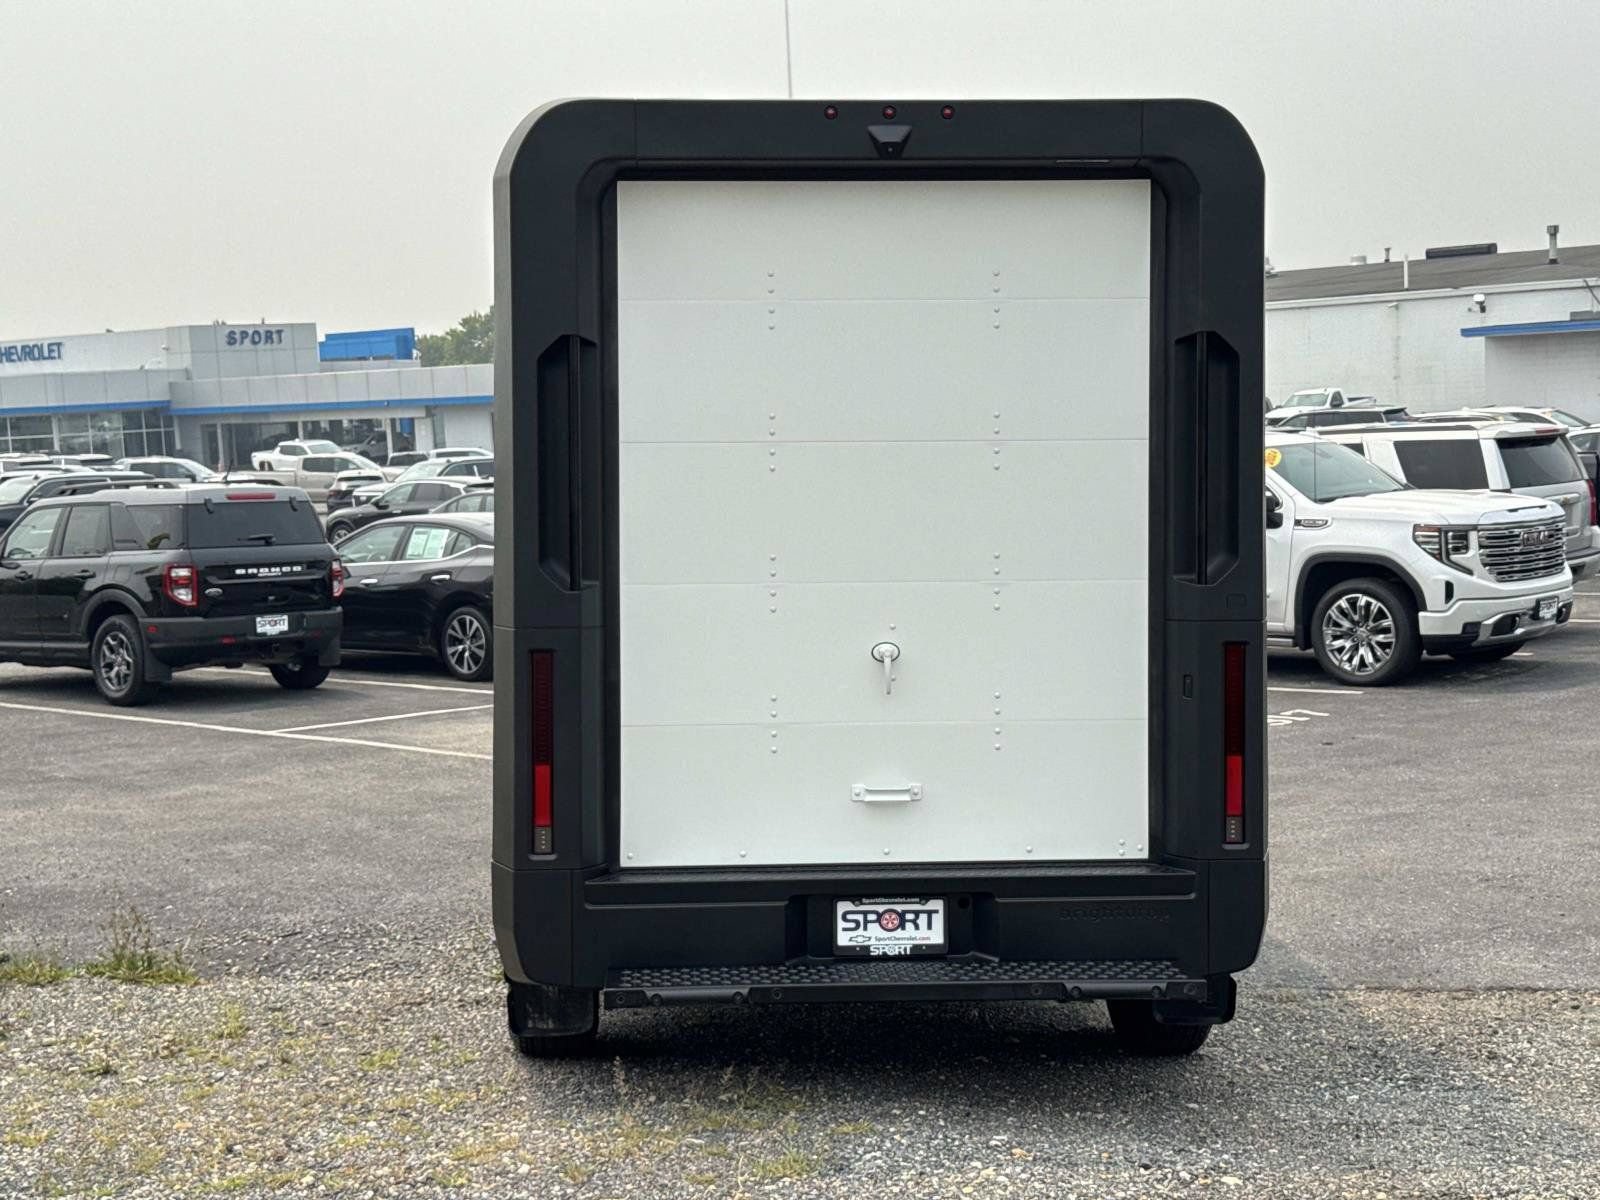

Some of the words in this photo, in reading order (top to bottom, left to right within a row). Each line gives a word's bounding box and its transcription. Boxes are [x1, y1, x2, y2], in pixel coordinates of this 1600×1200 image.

[225, 328, 284, 346] SPORT
[841, 908, 940, 932] SPORT
[869, 944, 913, 956] SPORT
